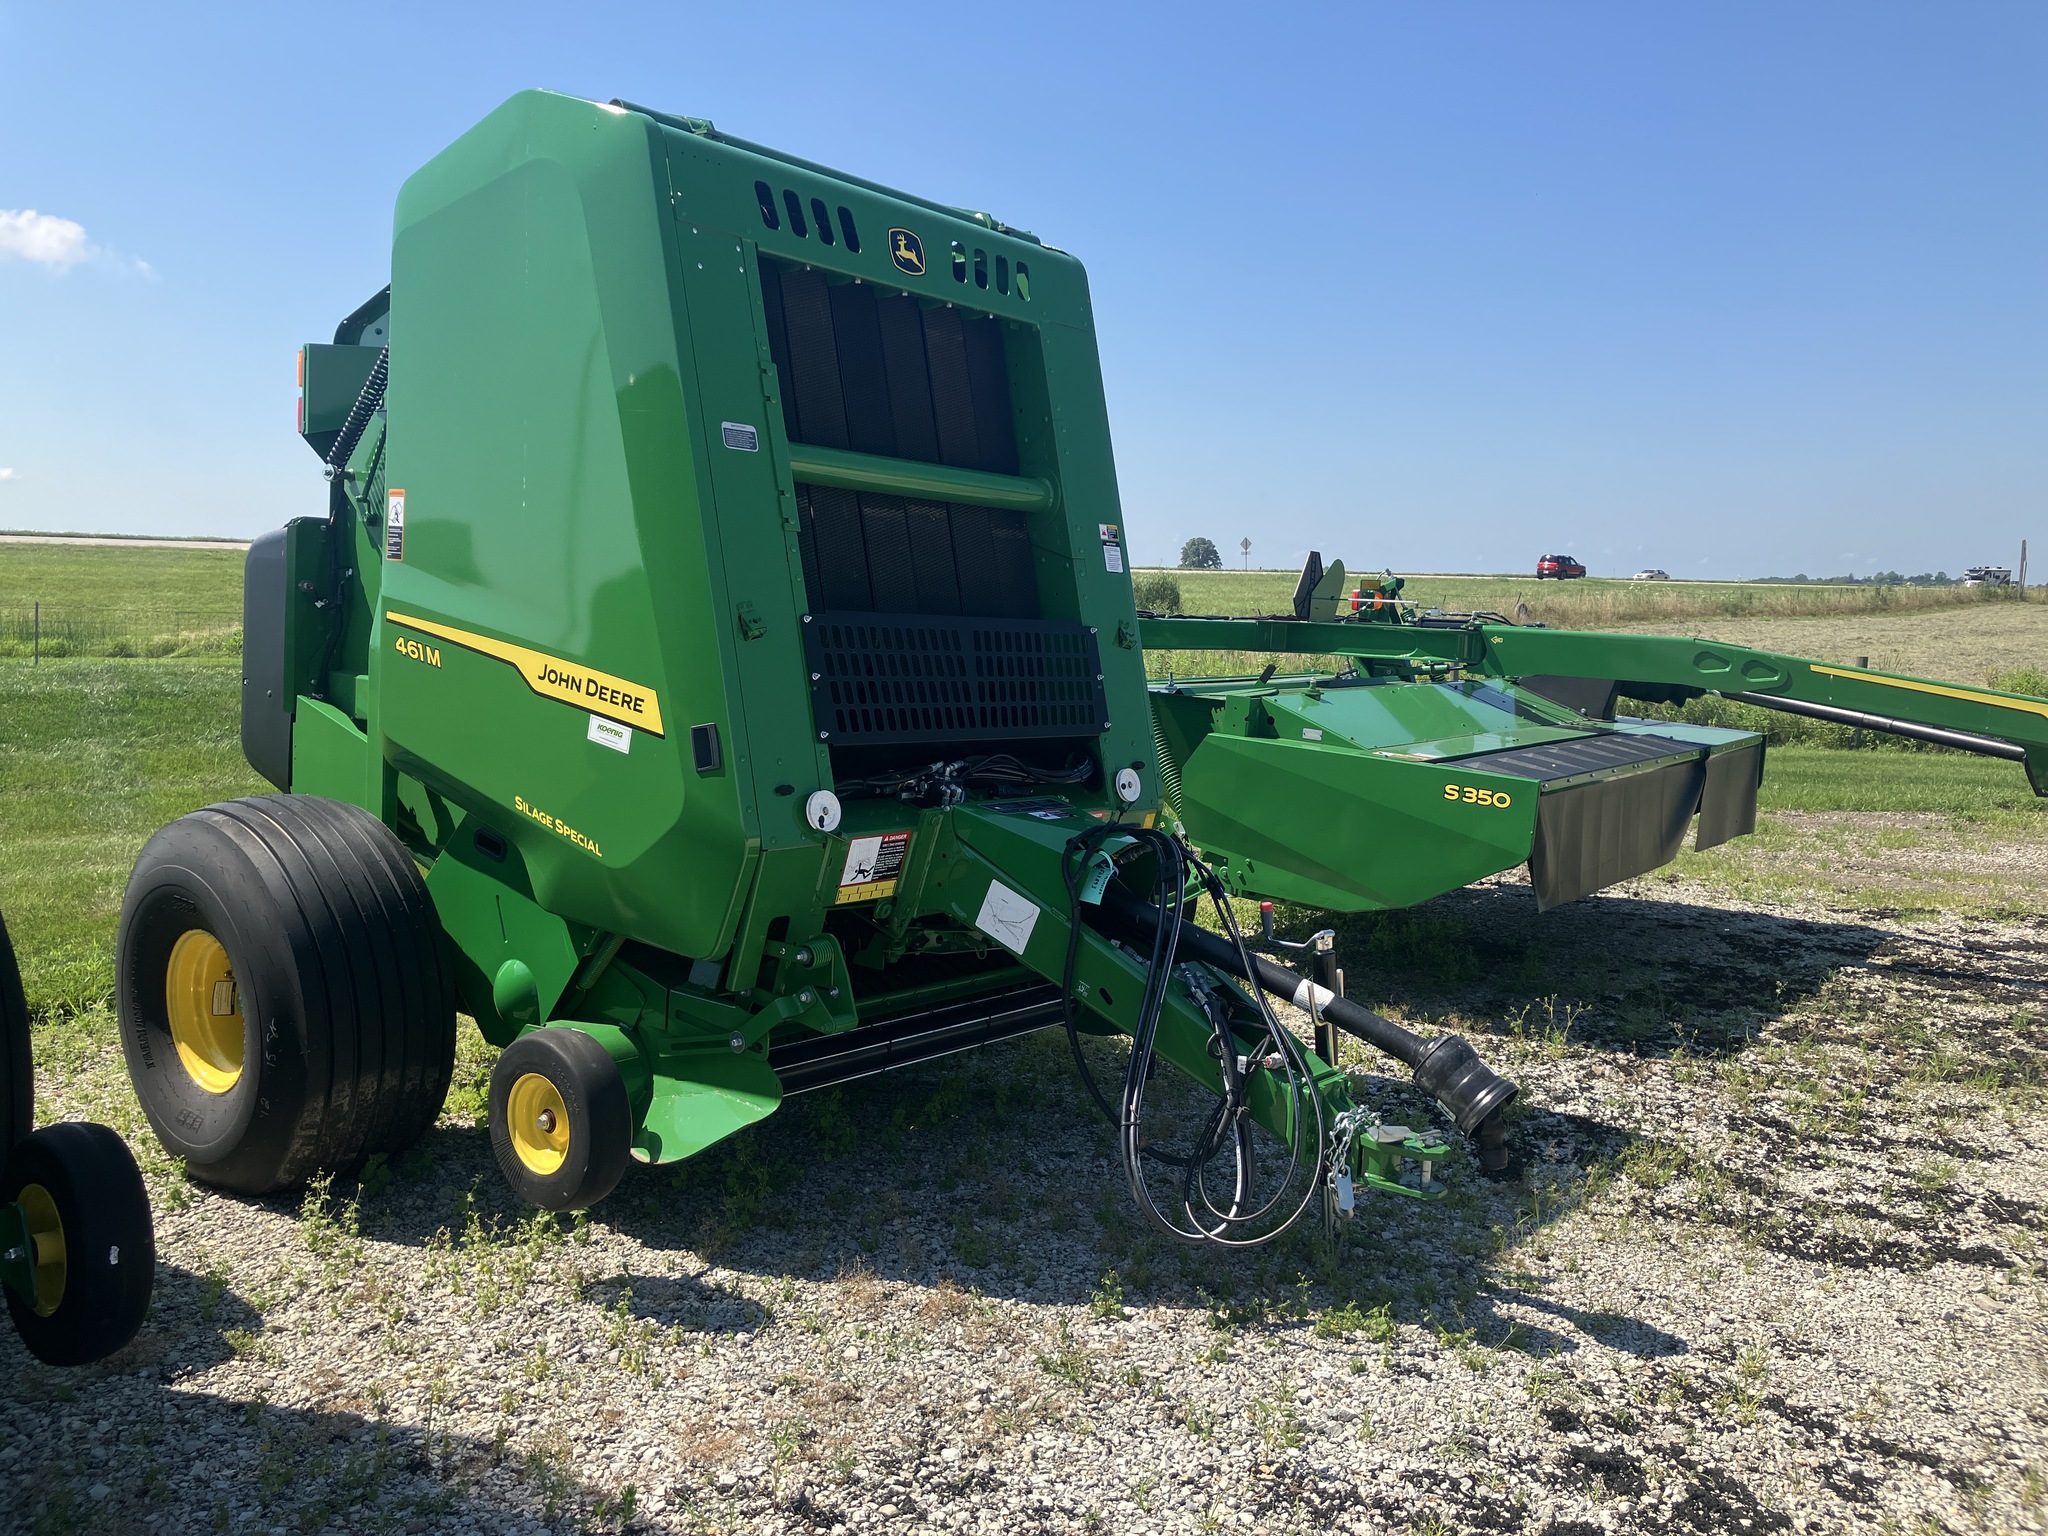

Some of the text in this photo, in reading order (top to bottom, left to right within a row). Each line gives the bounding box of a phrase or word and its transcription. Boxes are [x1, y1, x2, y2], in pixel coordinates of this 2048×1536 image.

[538, 664, 645, 713] JOHN DEERE
[1462, 787, 1511, 809] 350
[515, 795, 603, 857] SILAGE SPECIAL
[888, 833, 908, 841] DANGER
